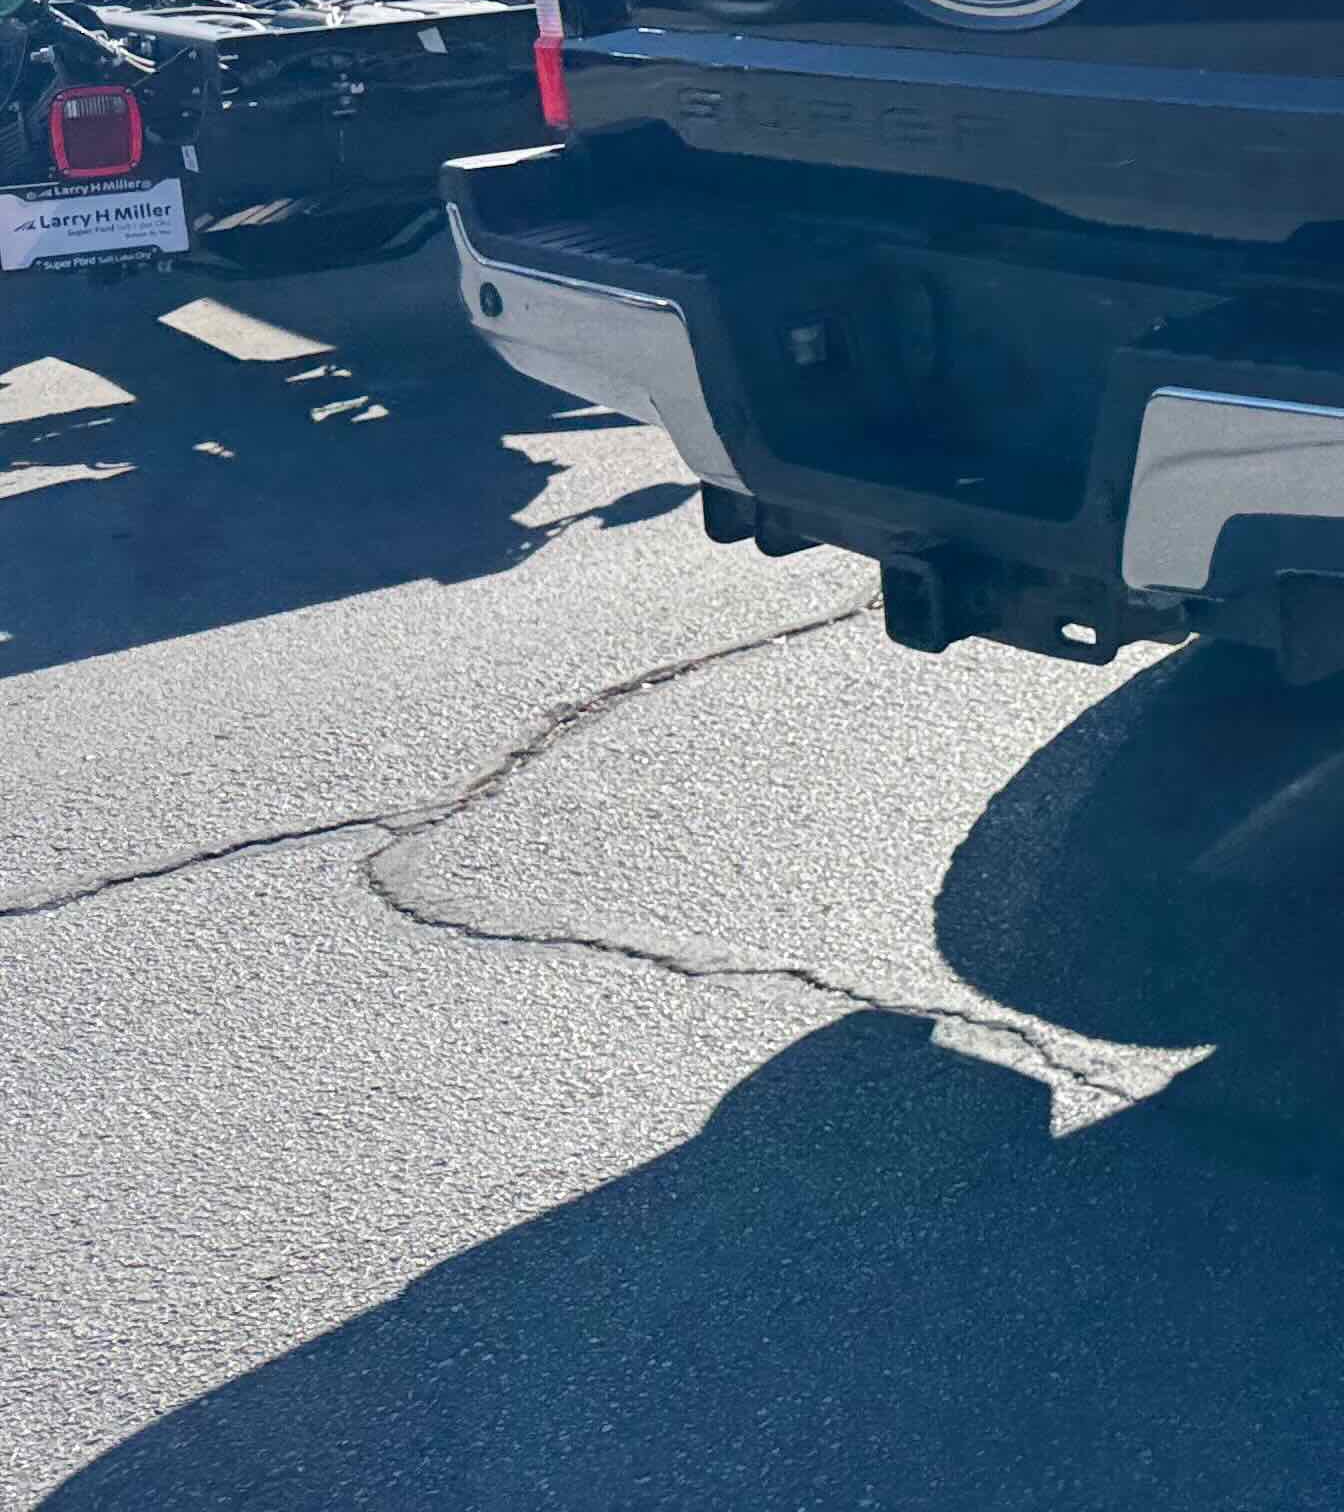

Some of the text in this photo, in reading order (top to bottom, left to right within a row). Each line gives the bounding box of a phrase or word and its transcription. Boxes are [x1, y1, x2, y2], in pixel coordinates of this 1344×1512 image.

[54, 178, 142, 197] Larry H Miller
[40, 203, 172, 229] Larry H Miller
